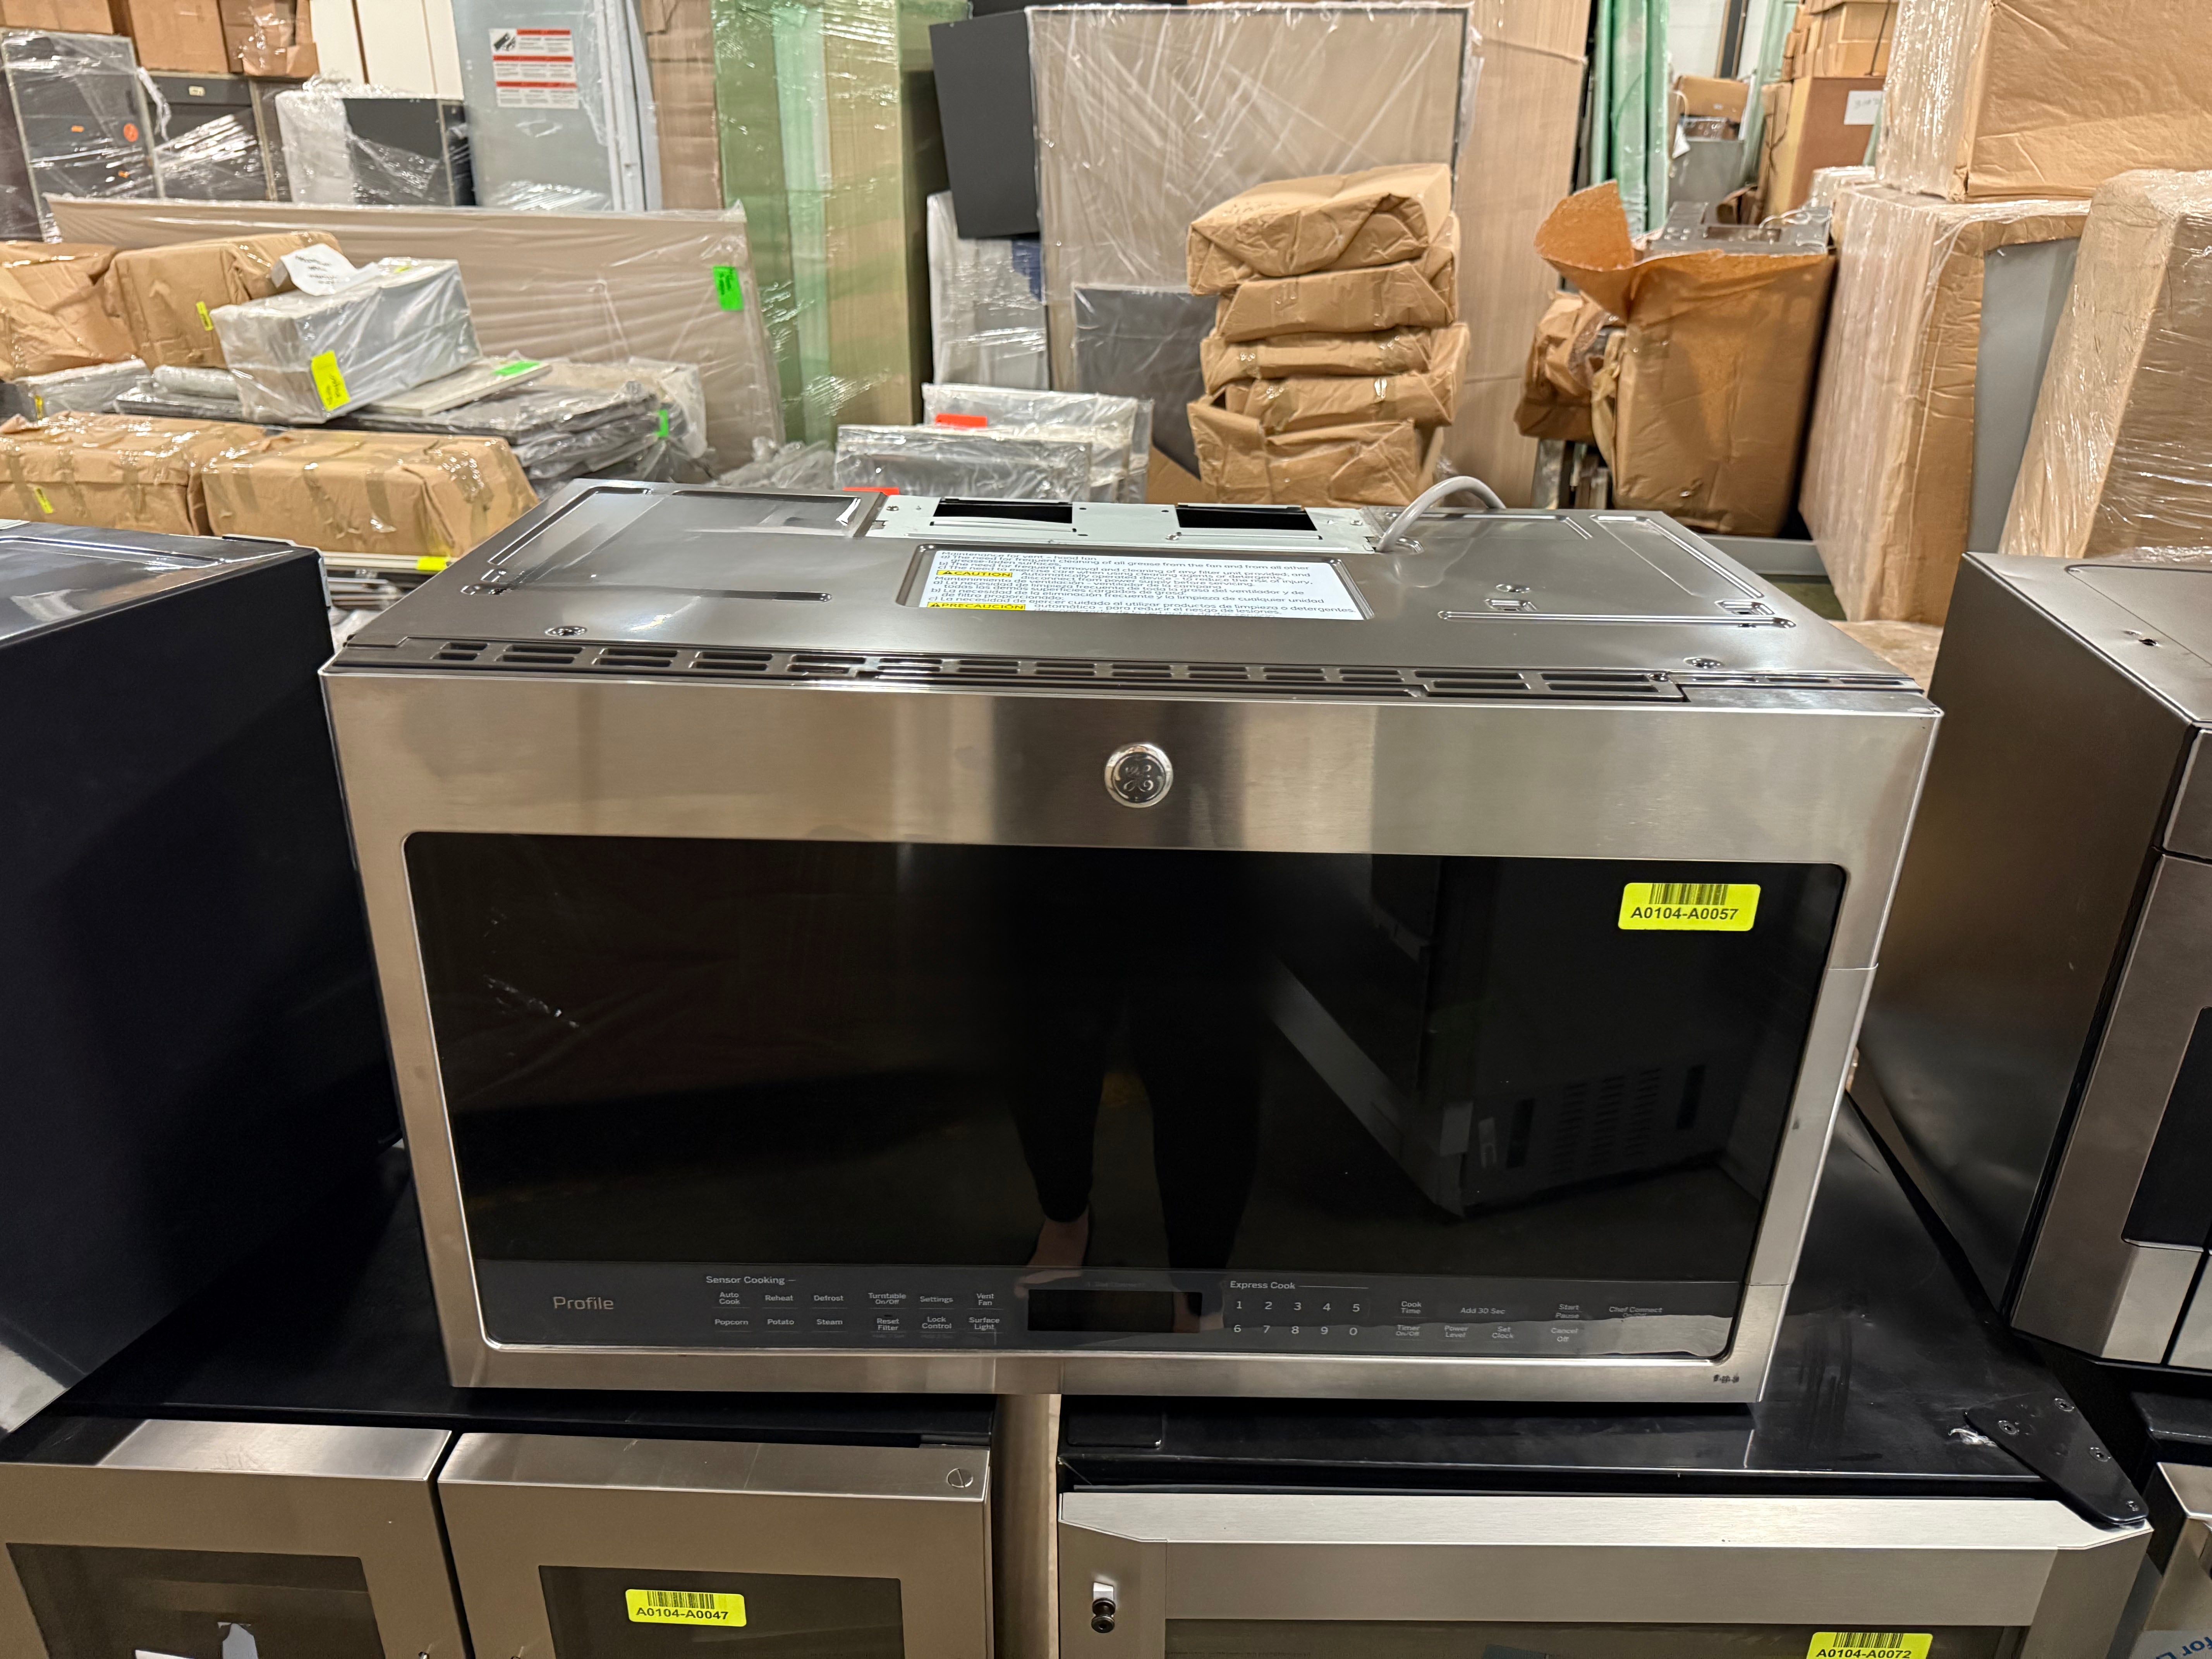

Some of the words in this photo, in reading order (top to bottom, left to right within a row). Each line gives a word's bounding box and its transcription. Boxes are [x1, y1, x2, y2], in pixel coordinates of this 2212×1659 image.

[1630, 907, 1739, 920] A0104-A0057
[744, 1277, 785, 1285] Cooking
[1230, 1281, 1268, 1290] Express
[553, 1297, 614, 1310] Profile
[1265, 1302, 1273, 1310] 2
[1294, 1302, 1301, 1310] 3
[1323, 1303, 1331, 1311] 4
[1352, 1304, 1360, 1312] 5
[1291, 1326, 1300, 1334] 8
[1321, 1326, 1328, 1334] 9
[1349, 1328, 1358, 1336] 0
[636, 1607, 729, 1620] A0104-A0047
[1816, 1649, 1912, 1659] A0104-A0072
